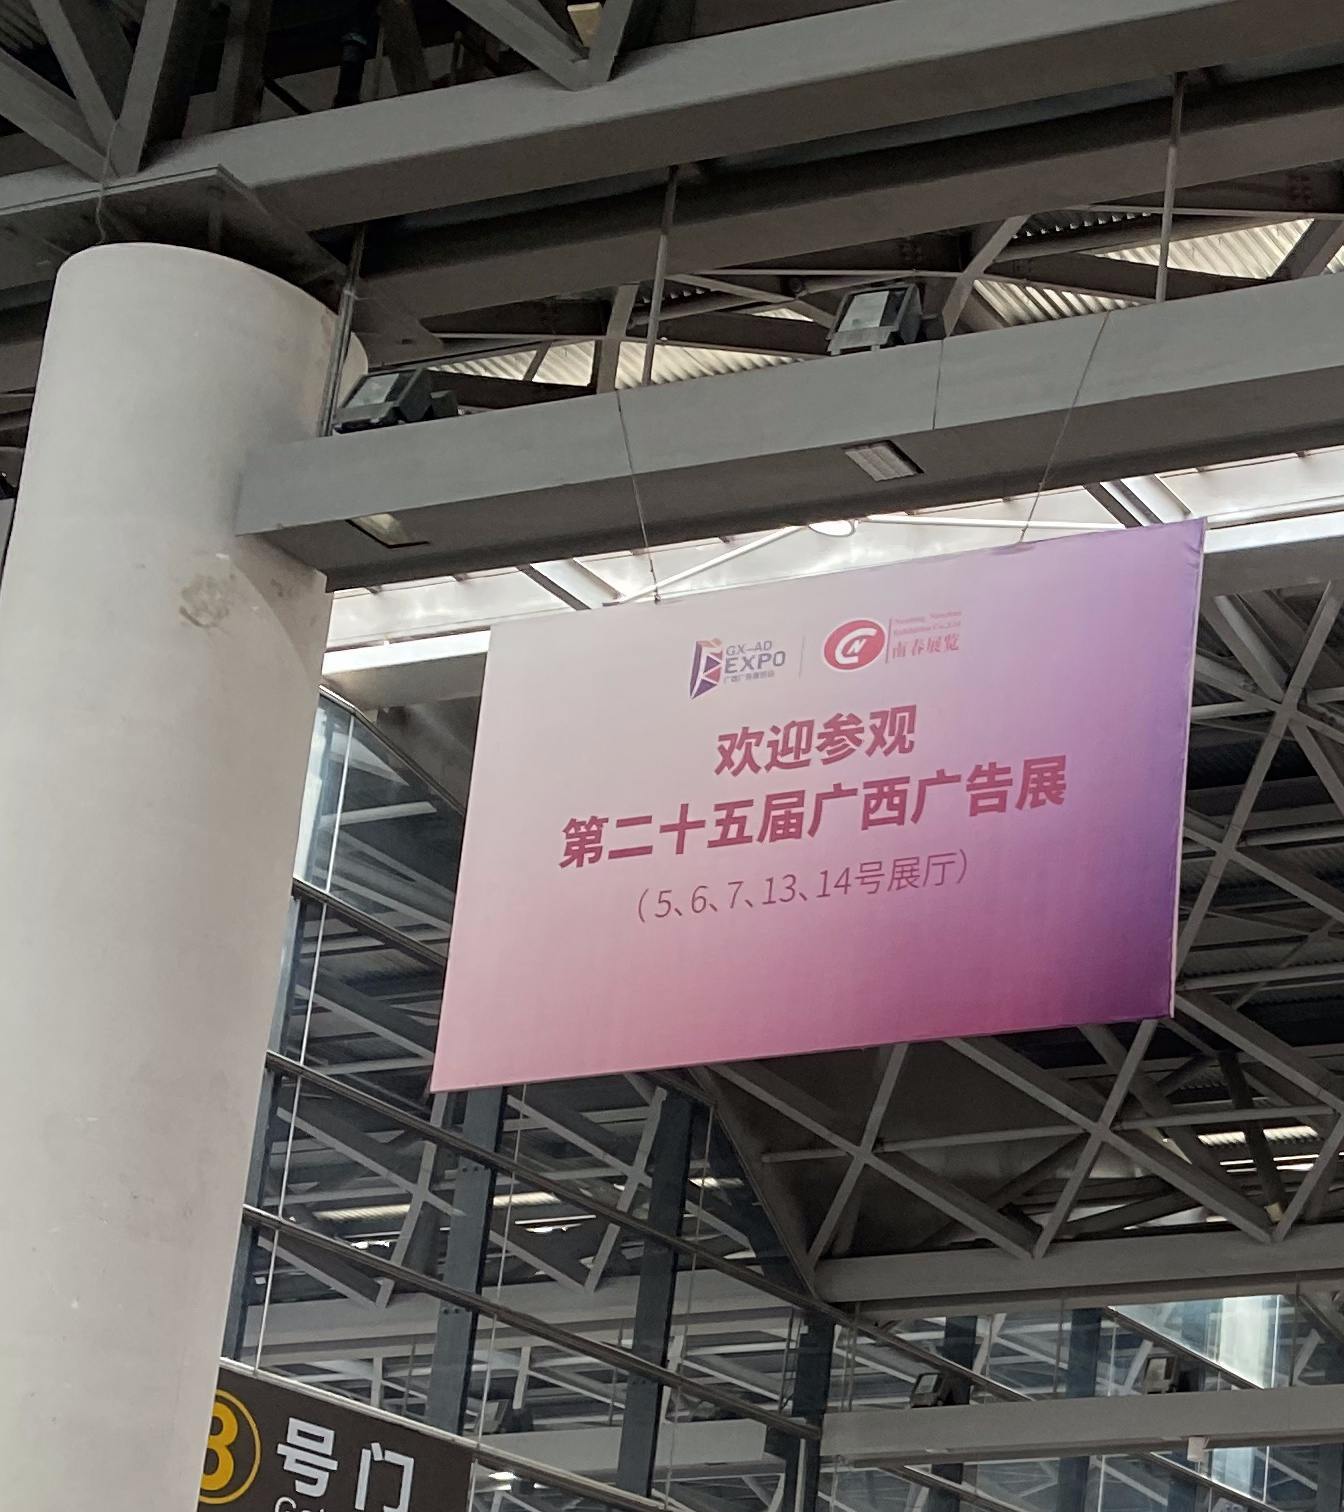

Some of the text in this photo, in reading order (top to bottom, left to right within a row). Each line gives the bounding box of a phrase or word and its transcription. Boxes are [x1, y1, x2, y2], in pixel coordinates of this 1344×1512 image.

[724, 651, 786, 675] EXPO
[725, 640, 772, 657] GX-AD
[713, 704, 917, 780] 欢迎参观
[558, 754, 1067, 870] 第二十五届广西广告展
